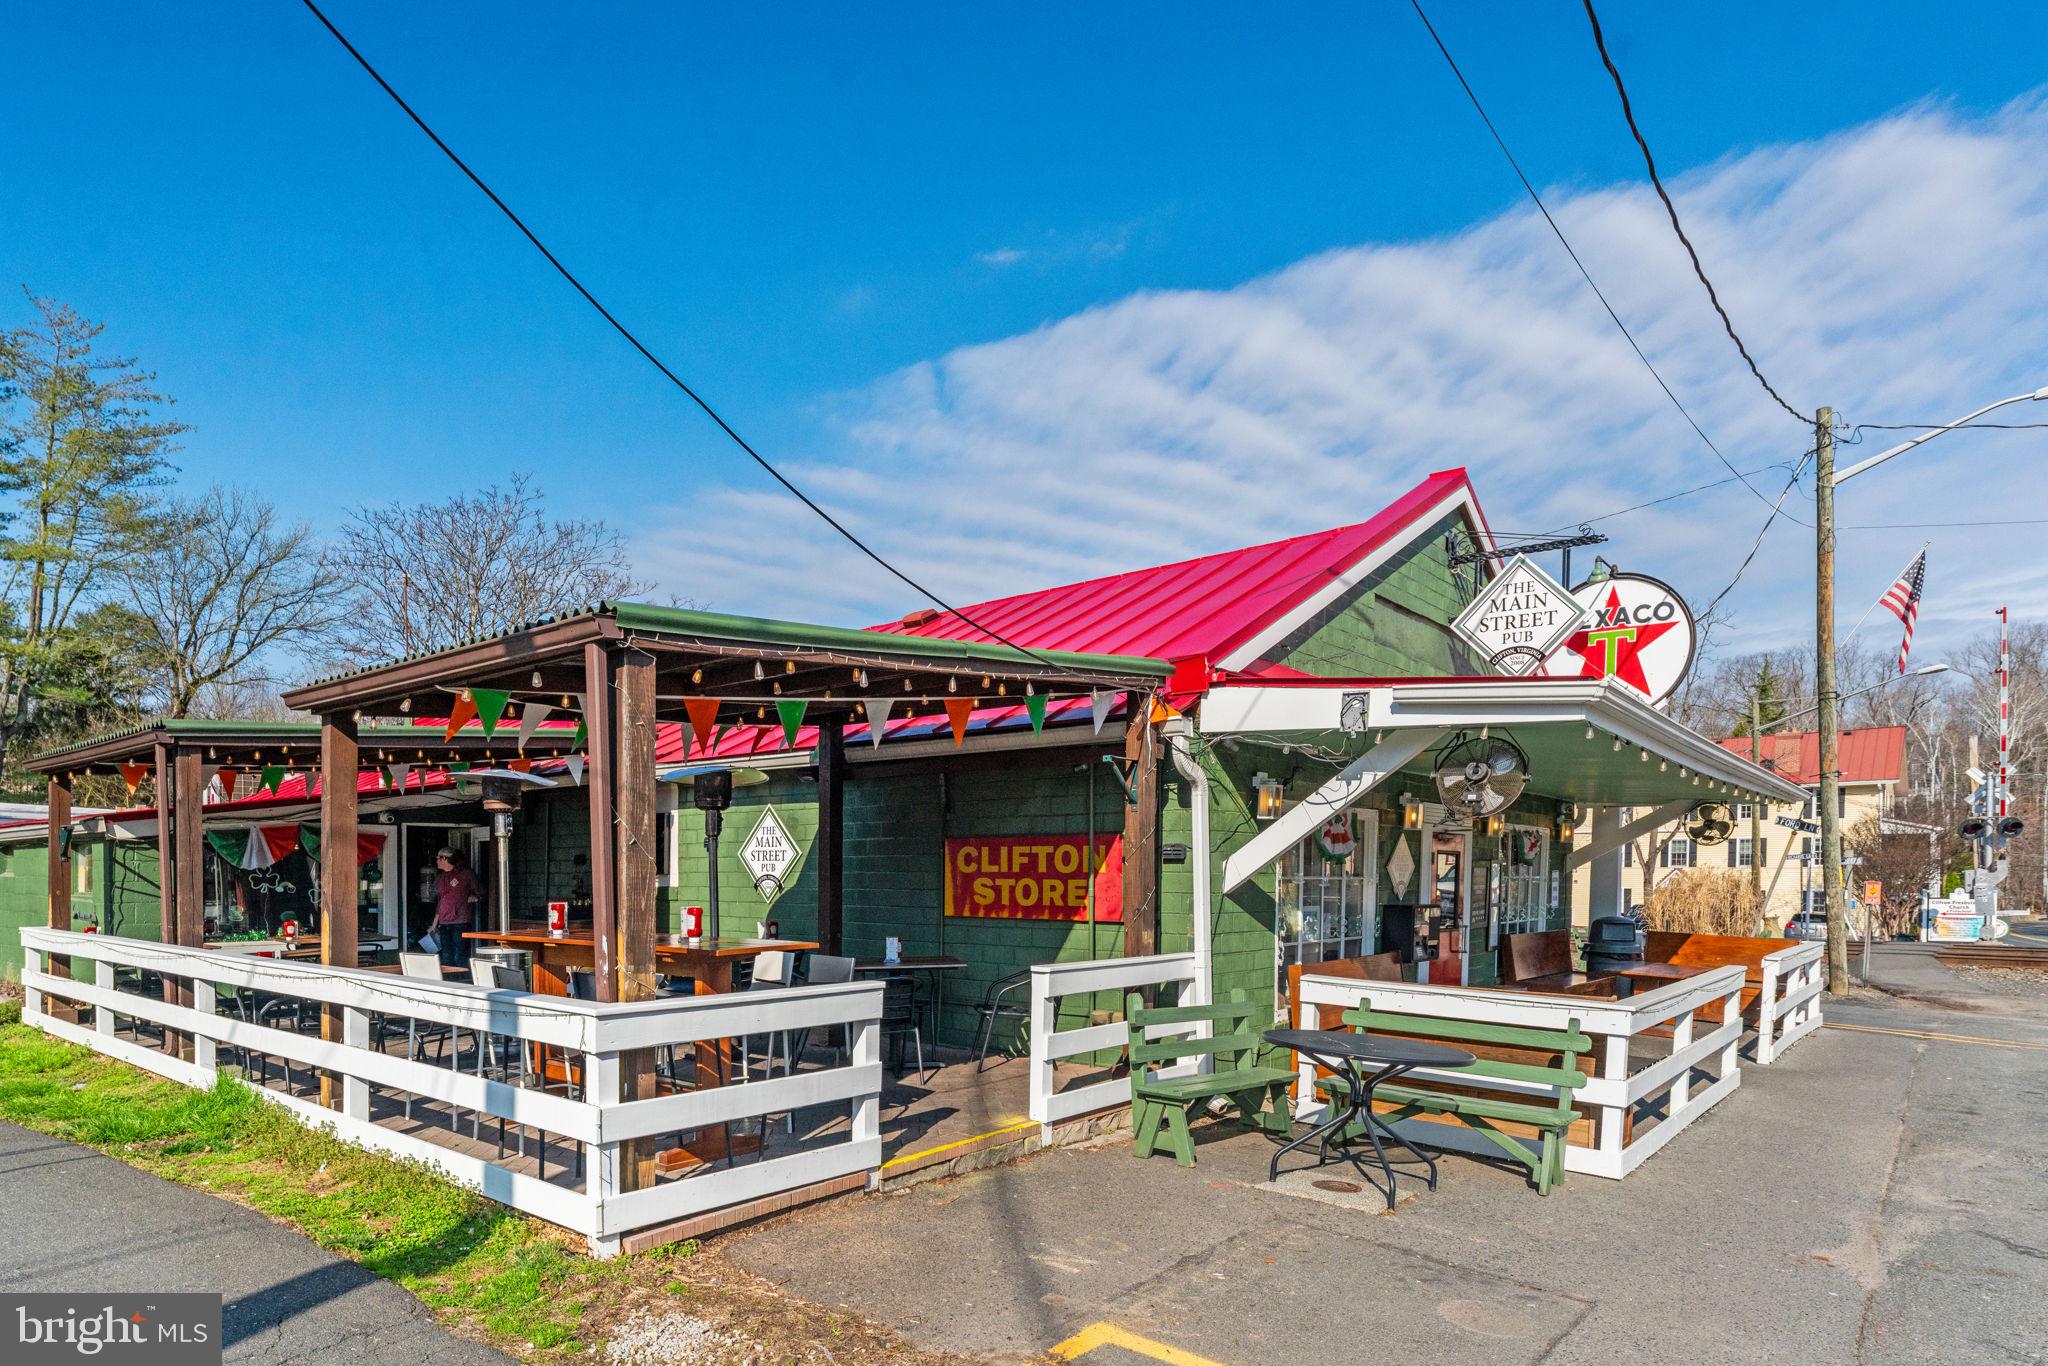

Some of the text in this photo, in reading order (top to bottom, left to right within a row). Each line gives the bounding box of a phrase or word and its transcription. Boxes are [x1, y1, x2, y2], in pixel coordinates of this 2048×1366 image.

[1503, 581, 1535, 595] THE
[1489, 592, 1548, 613] MAIN
[1479, 610, 1558, 632] STREET
[1502, 631, 1533, 644] PUB
[761, 826, 777, 835] THE
[1780, 817, 1815, 832] FORD LN
[755, 836, 782, 848] MAIN
[750, 850, 787, 862] STREET
[957, 844, 1106, 874] CLIFTON
[761, 863, 776, 872] PUB
[973, 877, 1088, 907] STORE
